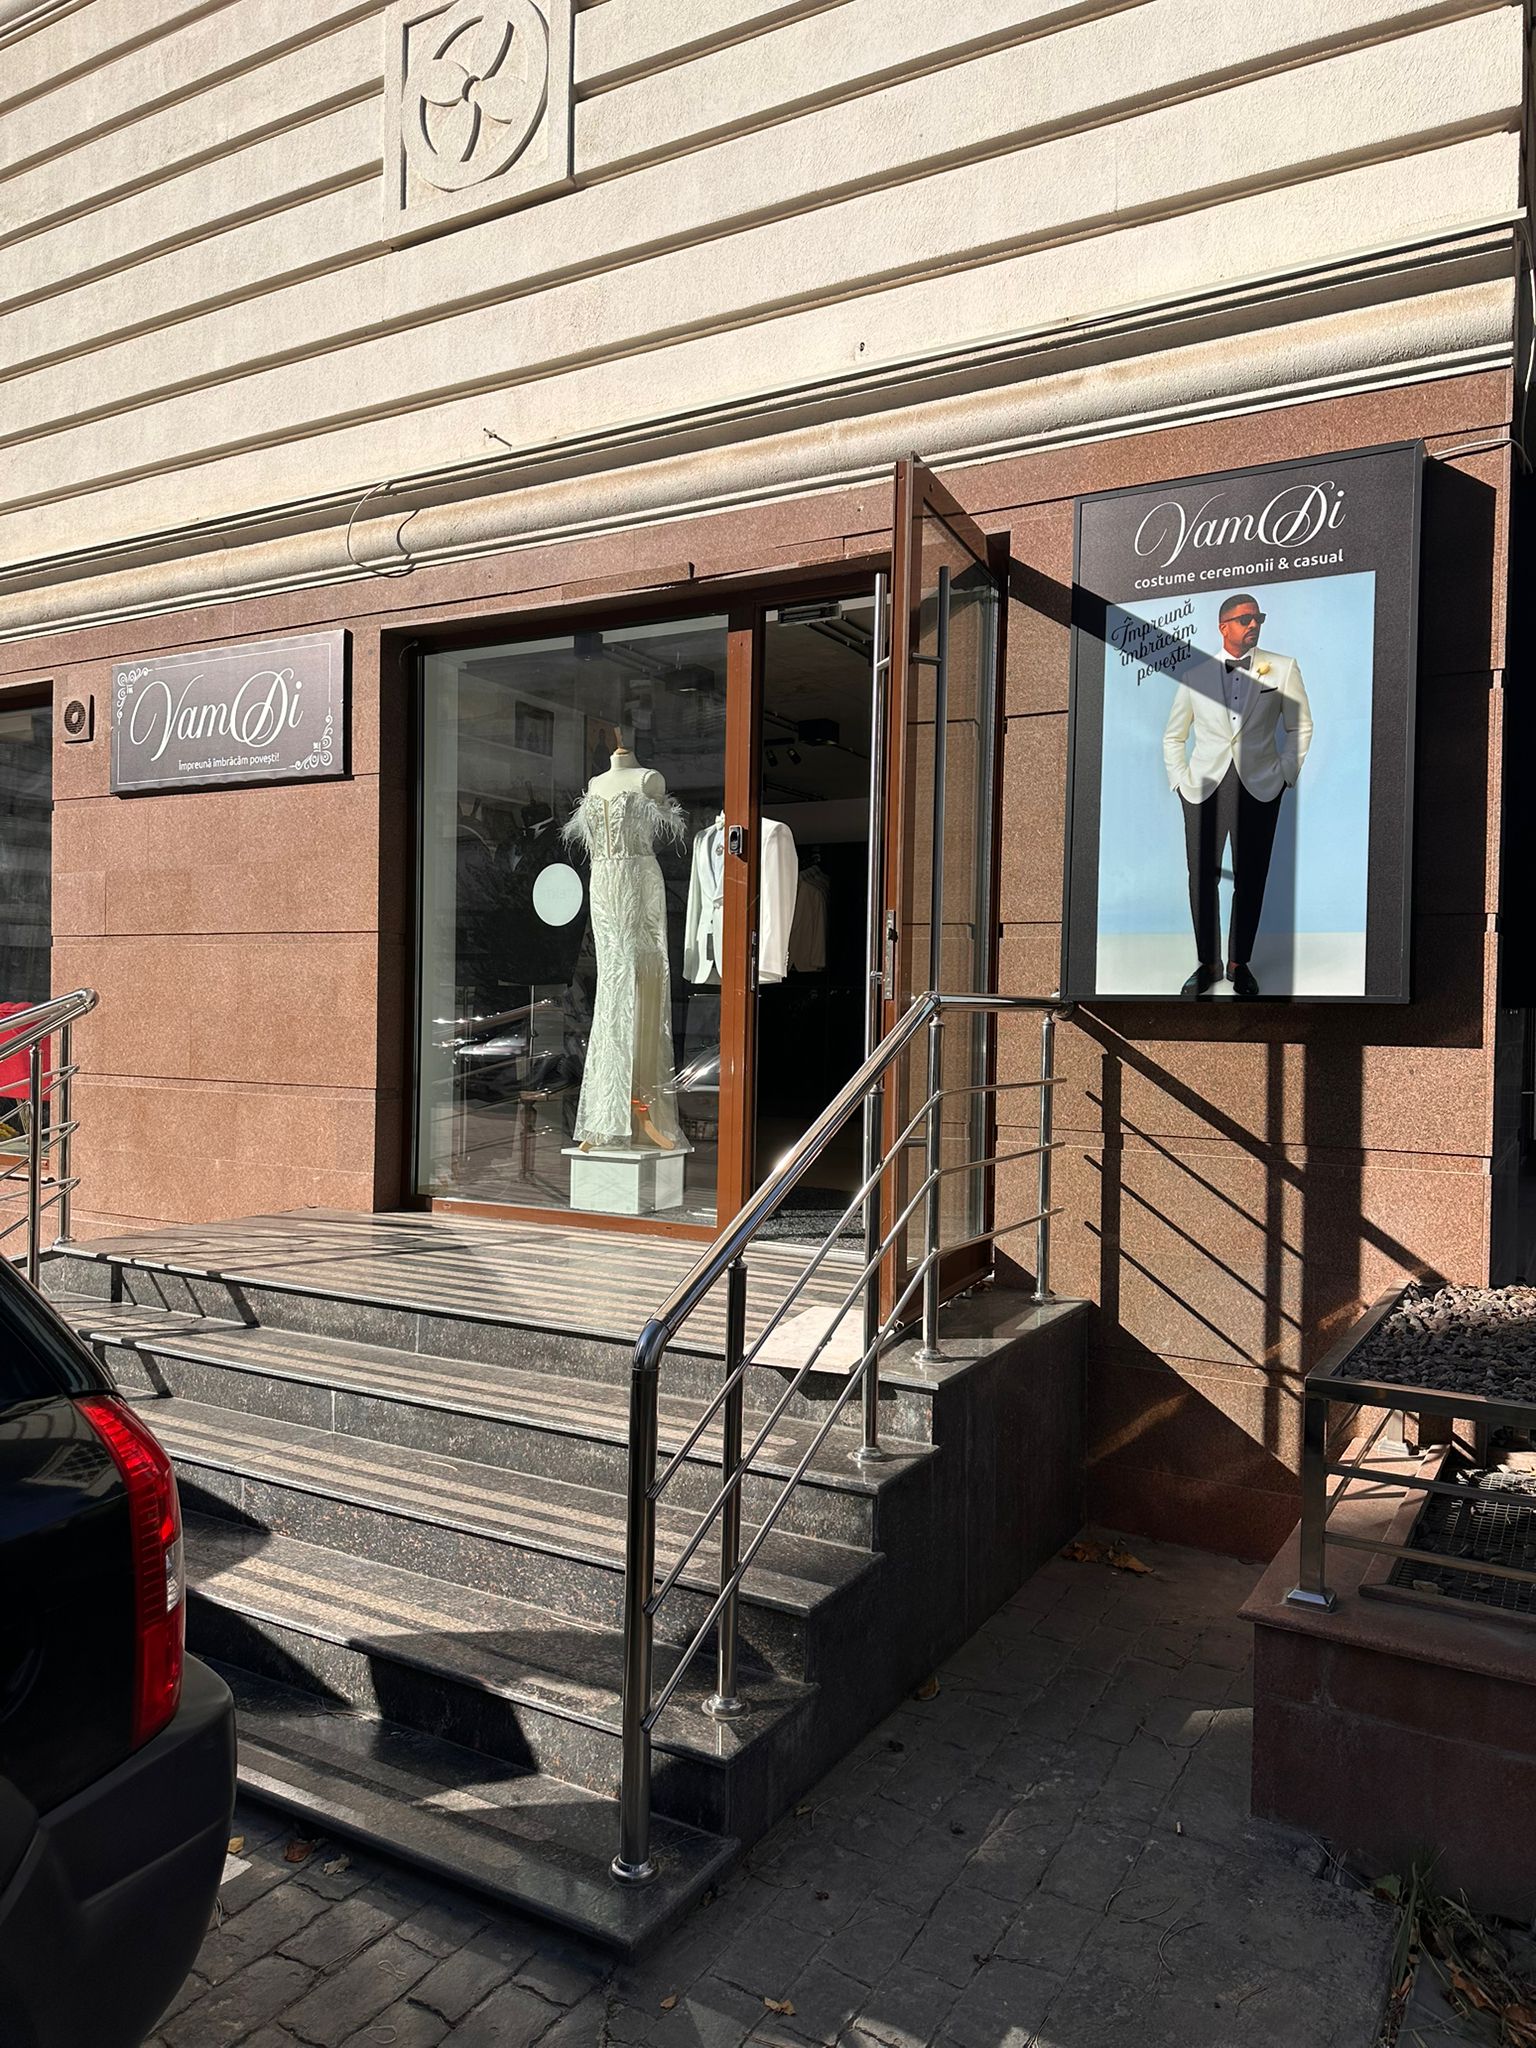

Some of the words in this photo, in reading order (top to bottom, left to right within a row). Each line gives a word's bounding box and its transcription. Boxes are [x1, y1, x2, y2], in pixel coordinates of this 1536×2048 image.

[1134, 480, 1347, 568] VamDi
[1134, 571, 1196, 590] costume
[1199, 558, 1274, 581] ceremonii
[1277, 558, 1289, 570] &
[1293, 548, 1344, 568] casual
[1111, 598, 1195, 651] Împreună
[1119, 624, 1198, 667] îmbrăcăm
[130, 668, 303, 761] VamDi
